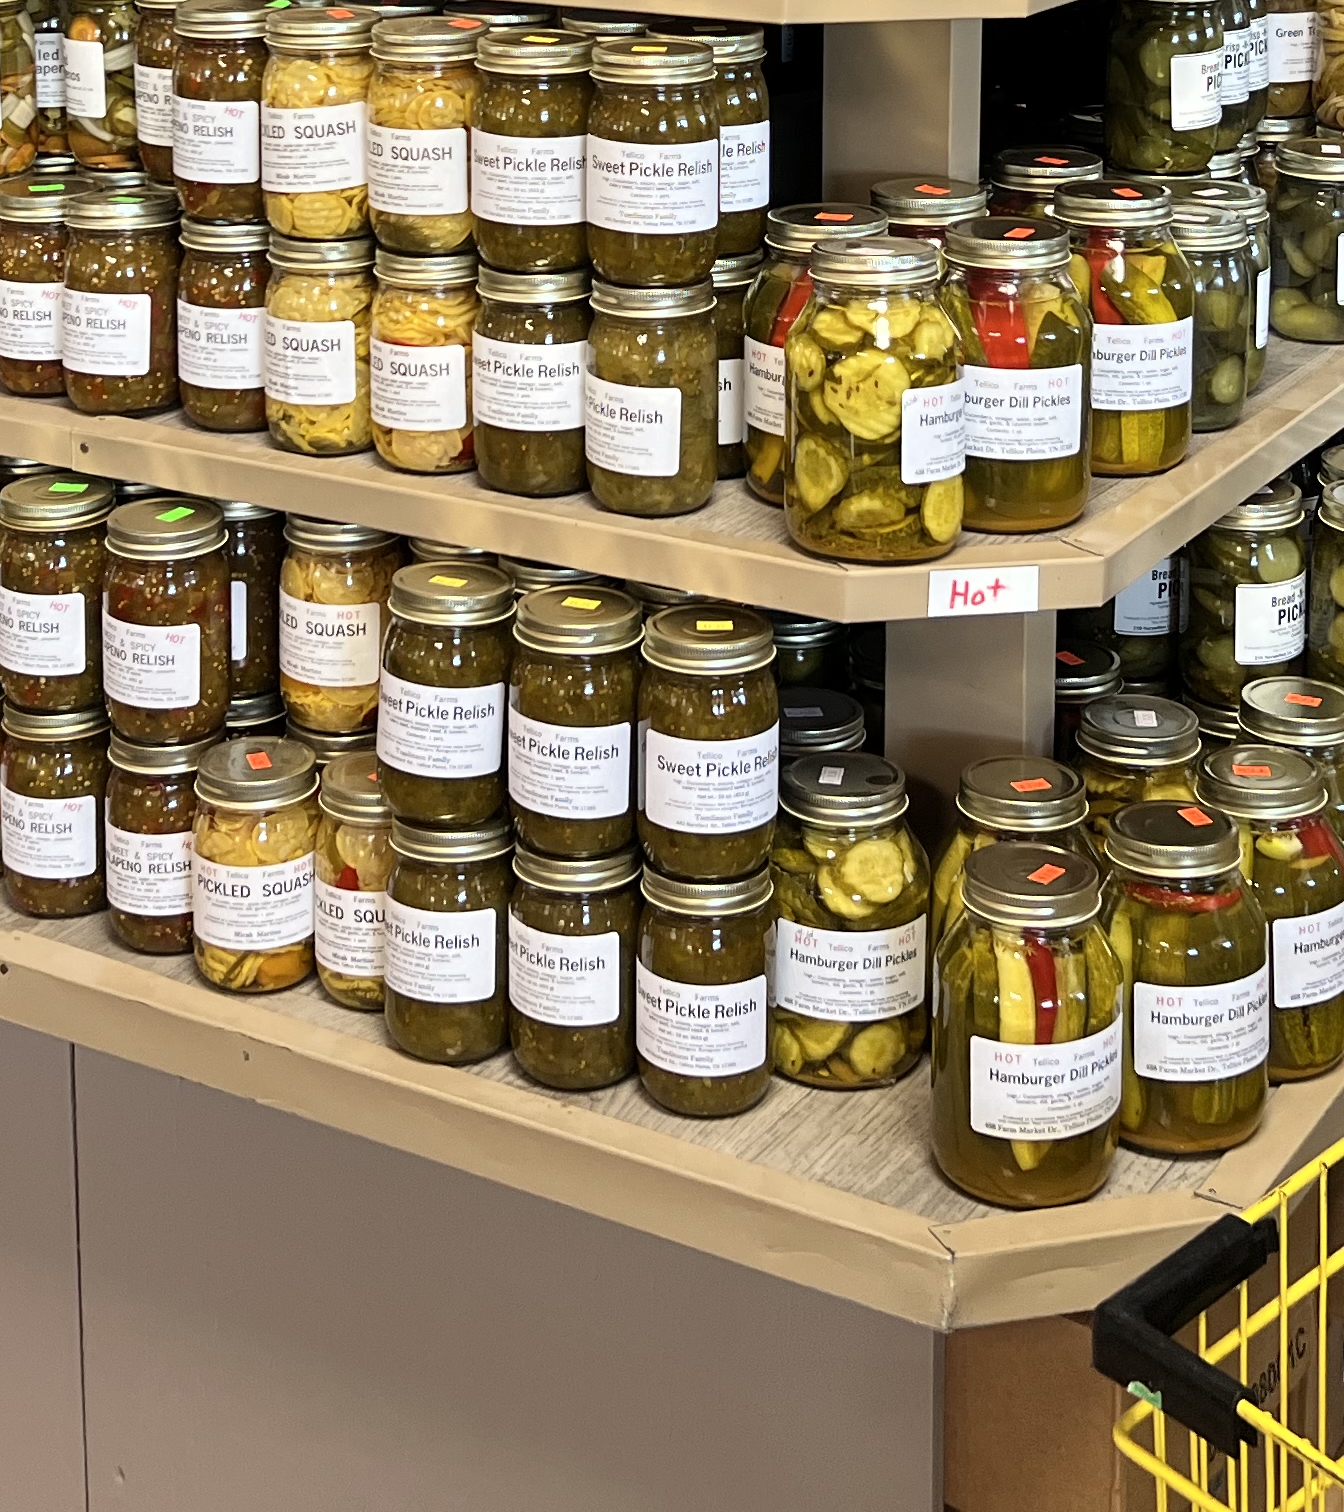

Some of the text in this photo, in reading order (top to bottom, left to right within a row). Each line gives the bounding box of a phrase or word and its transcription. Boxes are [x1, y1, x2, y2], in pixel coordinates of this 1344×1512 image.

[1276, 26, 1304, 40] Green
[193, 124, 234, 139] RELISH
[294, 121, 357, 140] SQUASH
[503, 155, 546, 173] Pickle
[592, 154, 712, 177] Sweet Pickle Relish
[12, 308, 52, 323] RELISH
[282, 336, 342, 353] SQUASH
[1138, 348, 1157, 362] Dill
[492, 360, 535, 378] Pickle
[1031, 392, 1071, 409] Pickles
[949, 576, 1008, 609] Hot
[1270, 594, 1297, 610] Bread
[20, 620, 60, 635] RELISH
[305, 620, 367, 638] SQUASH
[132, 652, 176, 667] RELISH
[406, 700, 495, 720] Pickle Relish
[657, 746, 778, 777] Sweet Pickle Relish
[148, 859, 192, 874] RELISH
[200, 864, 218, 877] HOT
[294, 859, 312, 872] HOT
[198, 871, 315, 898] PICKLED SQUASH
[435, 932, 480, 949] Relish
[790, 948, 917, 972] Hamburger Dill Pickles
[665, 997, 711, 1018] Pickle
[812, 1005, 837, 1015] Market
[1151, 991, 1268, 1027] Hamburger Dill Pickles
[1156, 996, 1183, 1007] HOT
[994, 1051, 1022, 1065] HOT
[989, 1050, 1118, 1087] Hamburger Dill Pickles
[1018, 1125, 1046, 1134] Market
